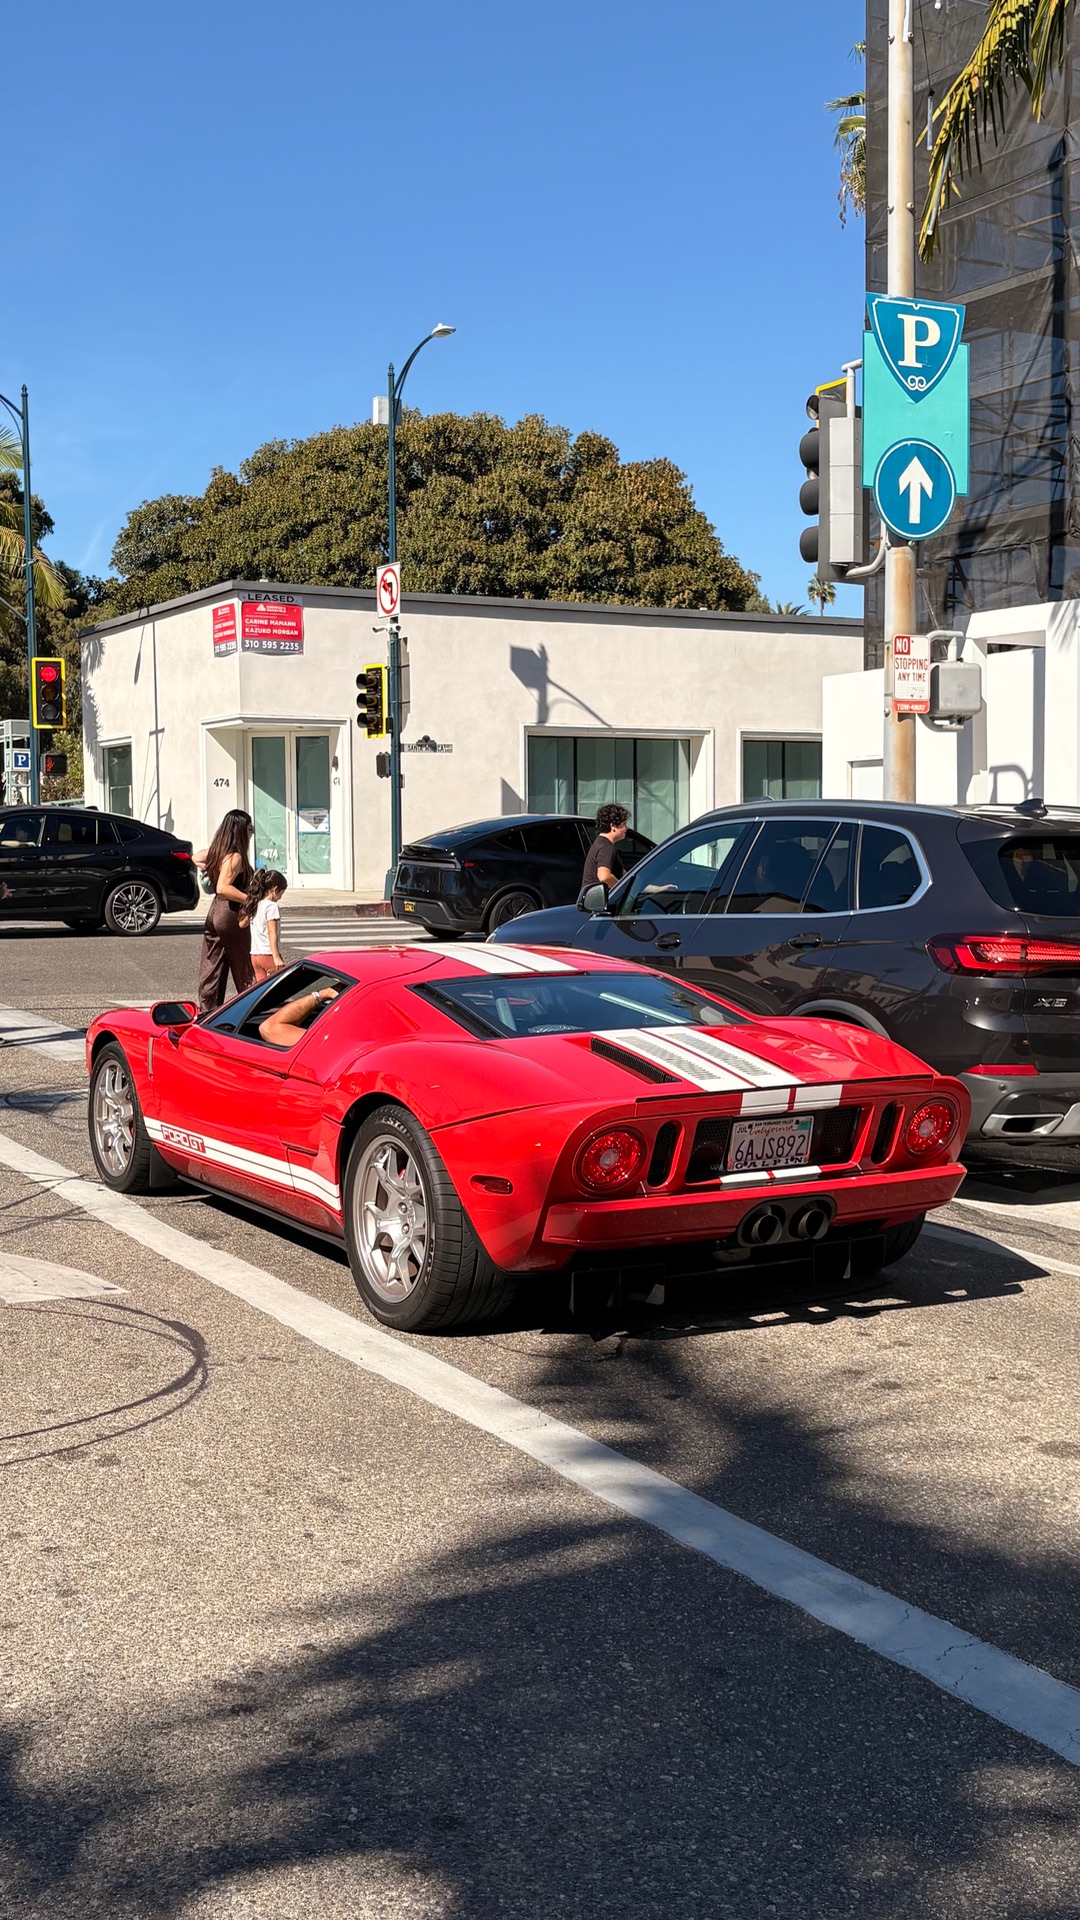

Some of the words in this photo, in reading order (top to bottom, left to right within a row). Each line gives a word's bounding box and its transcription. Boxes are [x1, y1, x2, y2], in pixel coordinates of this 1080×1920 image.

[898, 313, 941, 369] P
[248, 593, 295, 603] LEASED
[272, 628, 298, 636] MORGAN
[245, 640, 259, 648] 310
[262, 641, 277, 649] 595
[280, 642, 299, 650] 2235
[896, 638, 908, 653] NO
[895, 658, 928, 670] STOPPING
[898, 672, 910, 681] ANY
[913, 673, 926, 682] TIME
[897, 703, 925, 711] TOW-AWAY
[17, 754, 27, 766] P
[213, 778, 230, 787] 474
[1033, 997, 1068, 1008] X5
[748, 1124, 797, 1138] California
[161, 1126, 190, 1148] FORD
[189, 1135, 206, 1153] GT
[735, 1134, 806, 1162] 6AJS892
[735, 1156, 803, 1169] GALPIN
